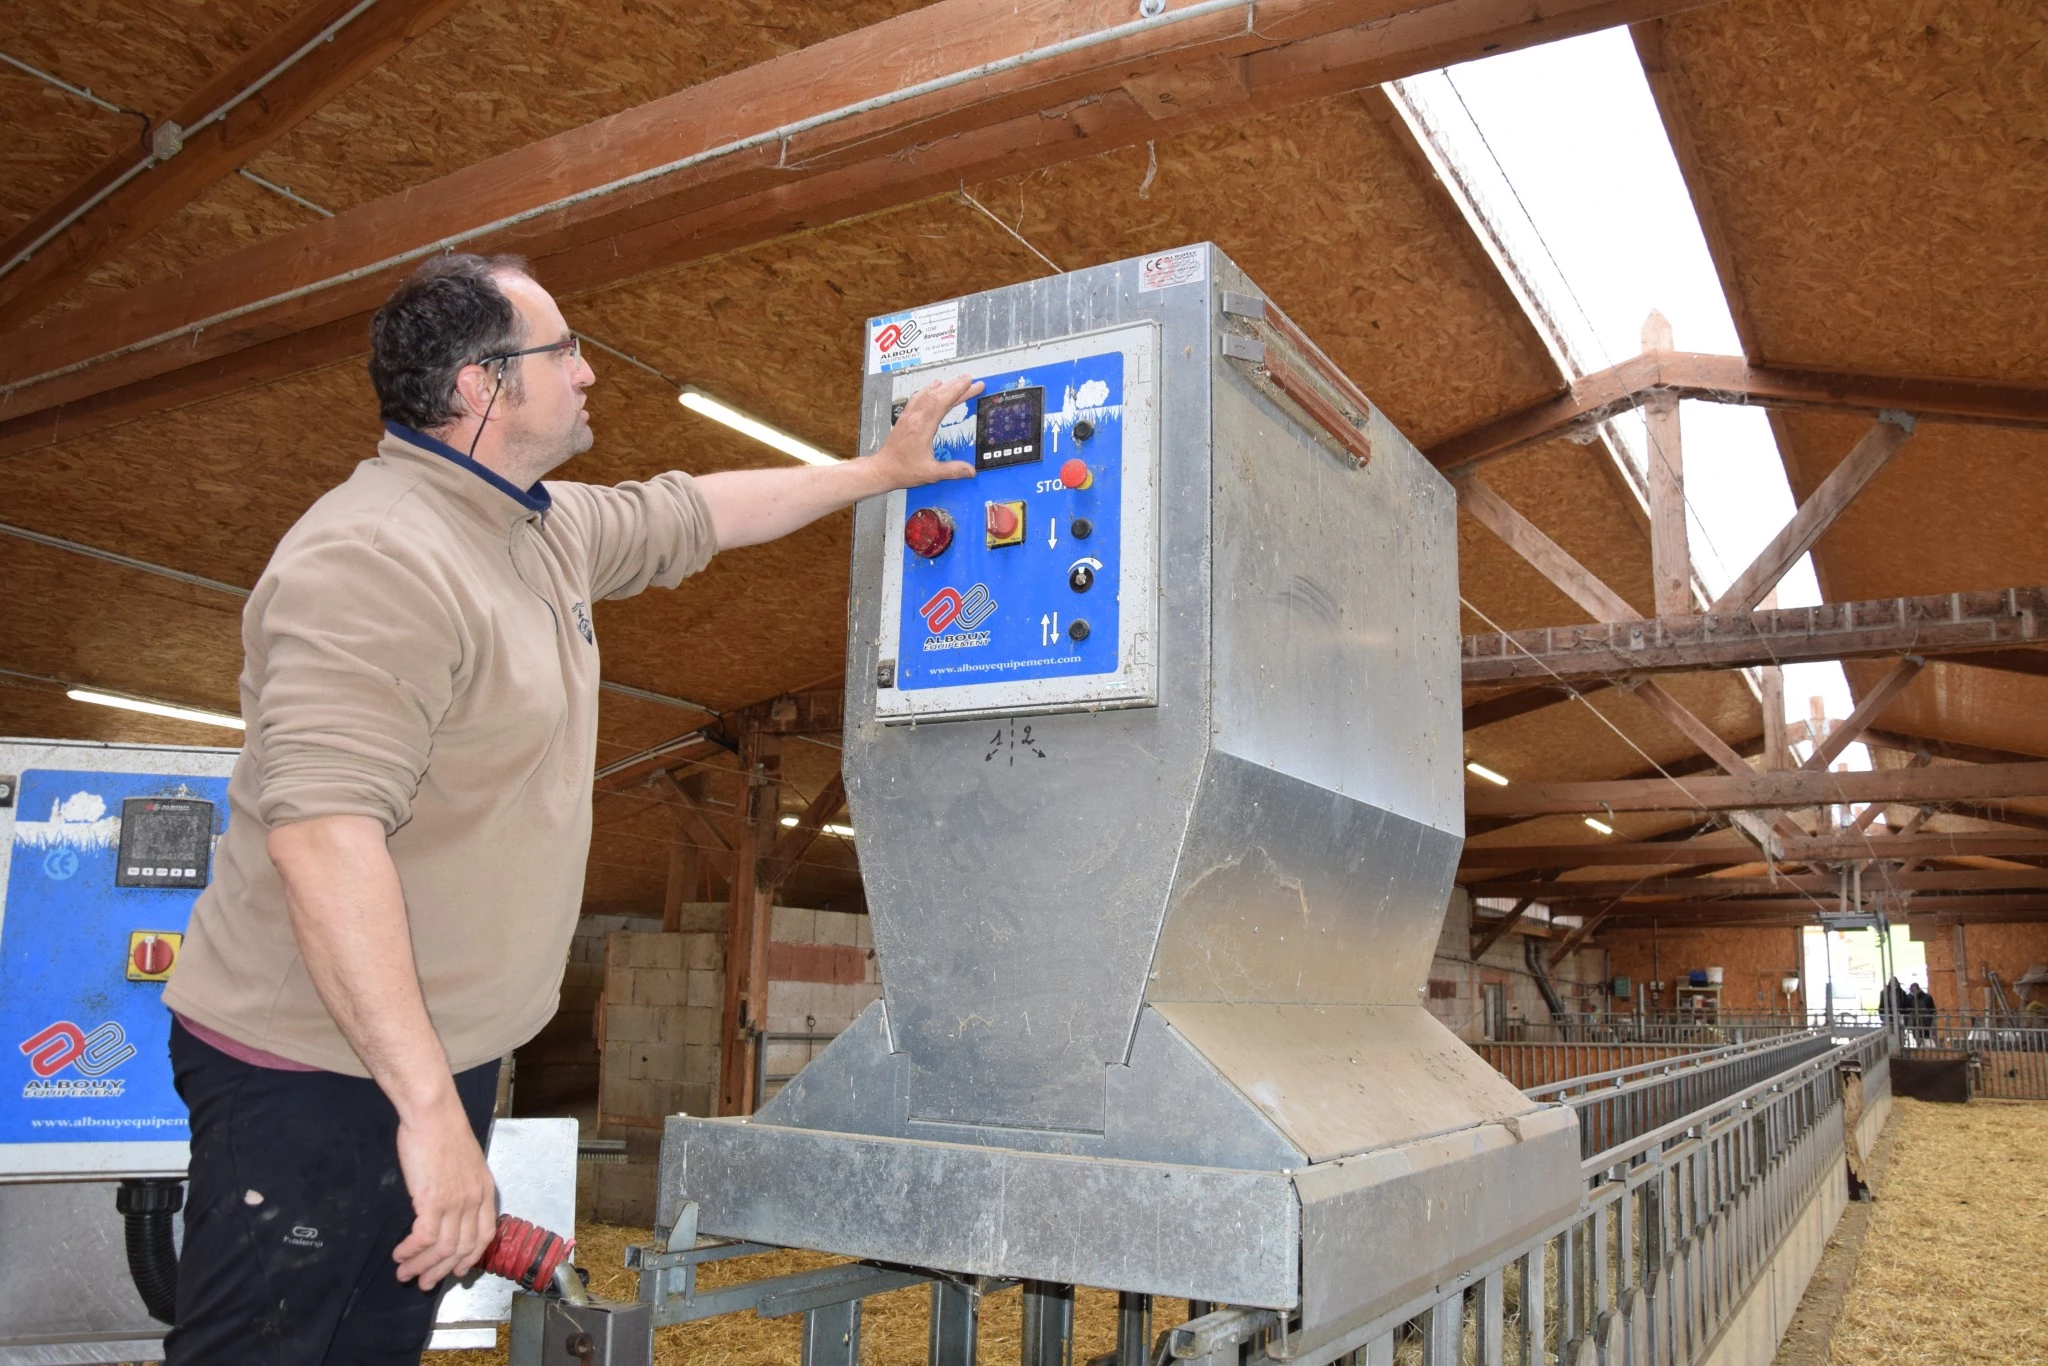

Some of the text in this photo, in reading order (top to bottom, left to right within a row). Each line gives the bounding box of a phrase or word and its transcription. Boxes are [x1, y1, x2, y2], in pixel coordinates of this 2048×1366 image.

[1146, 258, 1162, 272] CE
[880, 347, 920, 360] ALBOUY
[880, 352, 920, 365] EQUIPEMENT
[1036, 478, 1067, 494] STO
[924, 631, 991, 646] ALBOUY
[923, 639, 991, 652] EQUIPEMENT
[929, 655, 1082, 676] www.albouyequipement.com
[990, 725, 1036, 746] 1 2
[25, 1079, 125, 1090] ALBOUY
[23, 1088, 125, 1098] EQUIPEMENT
